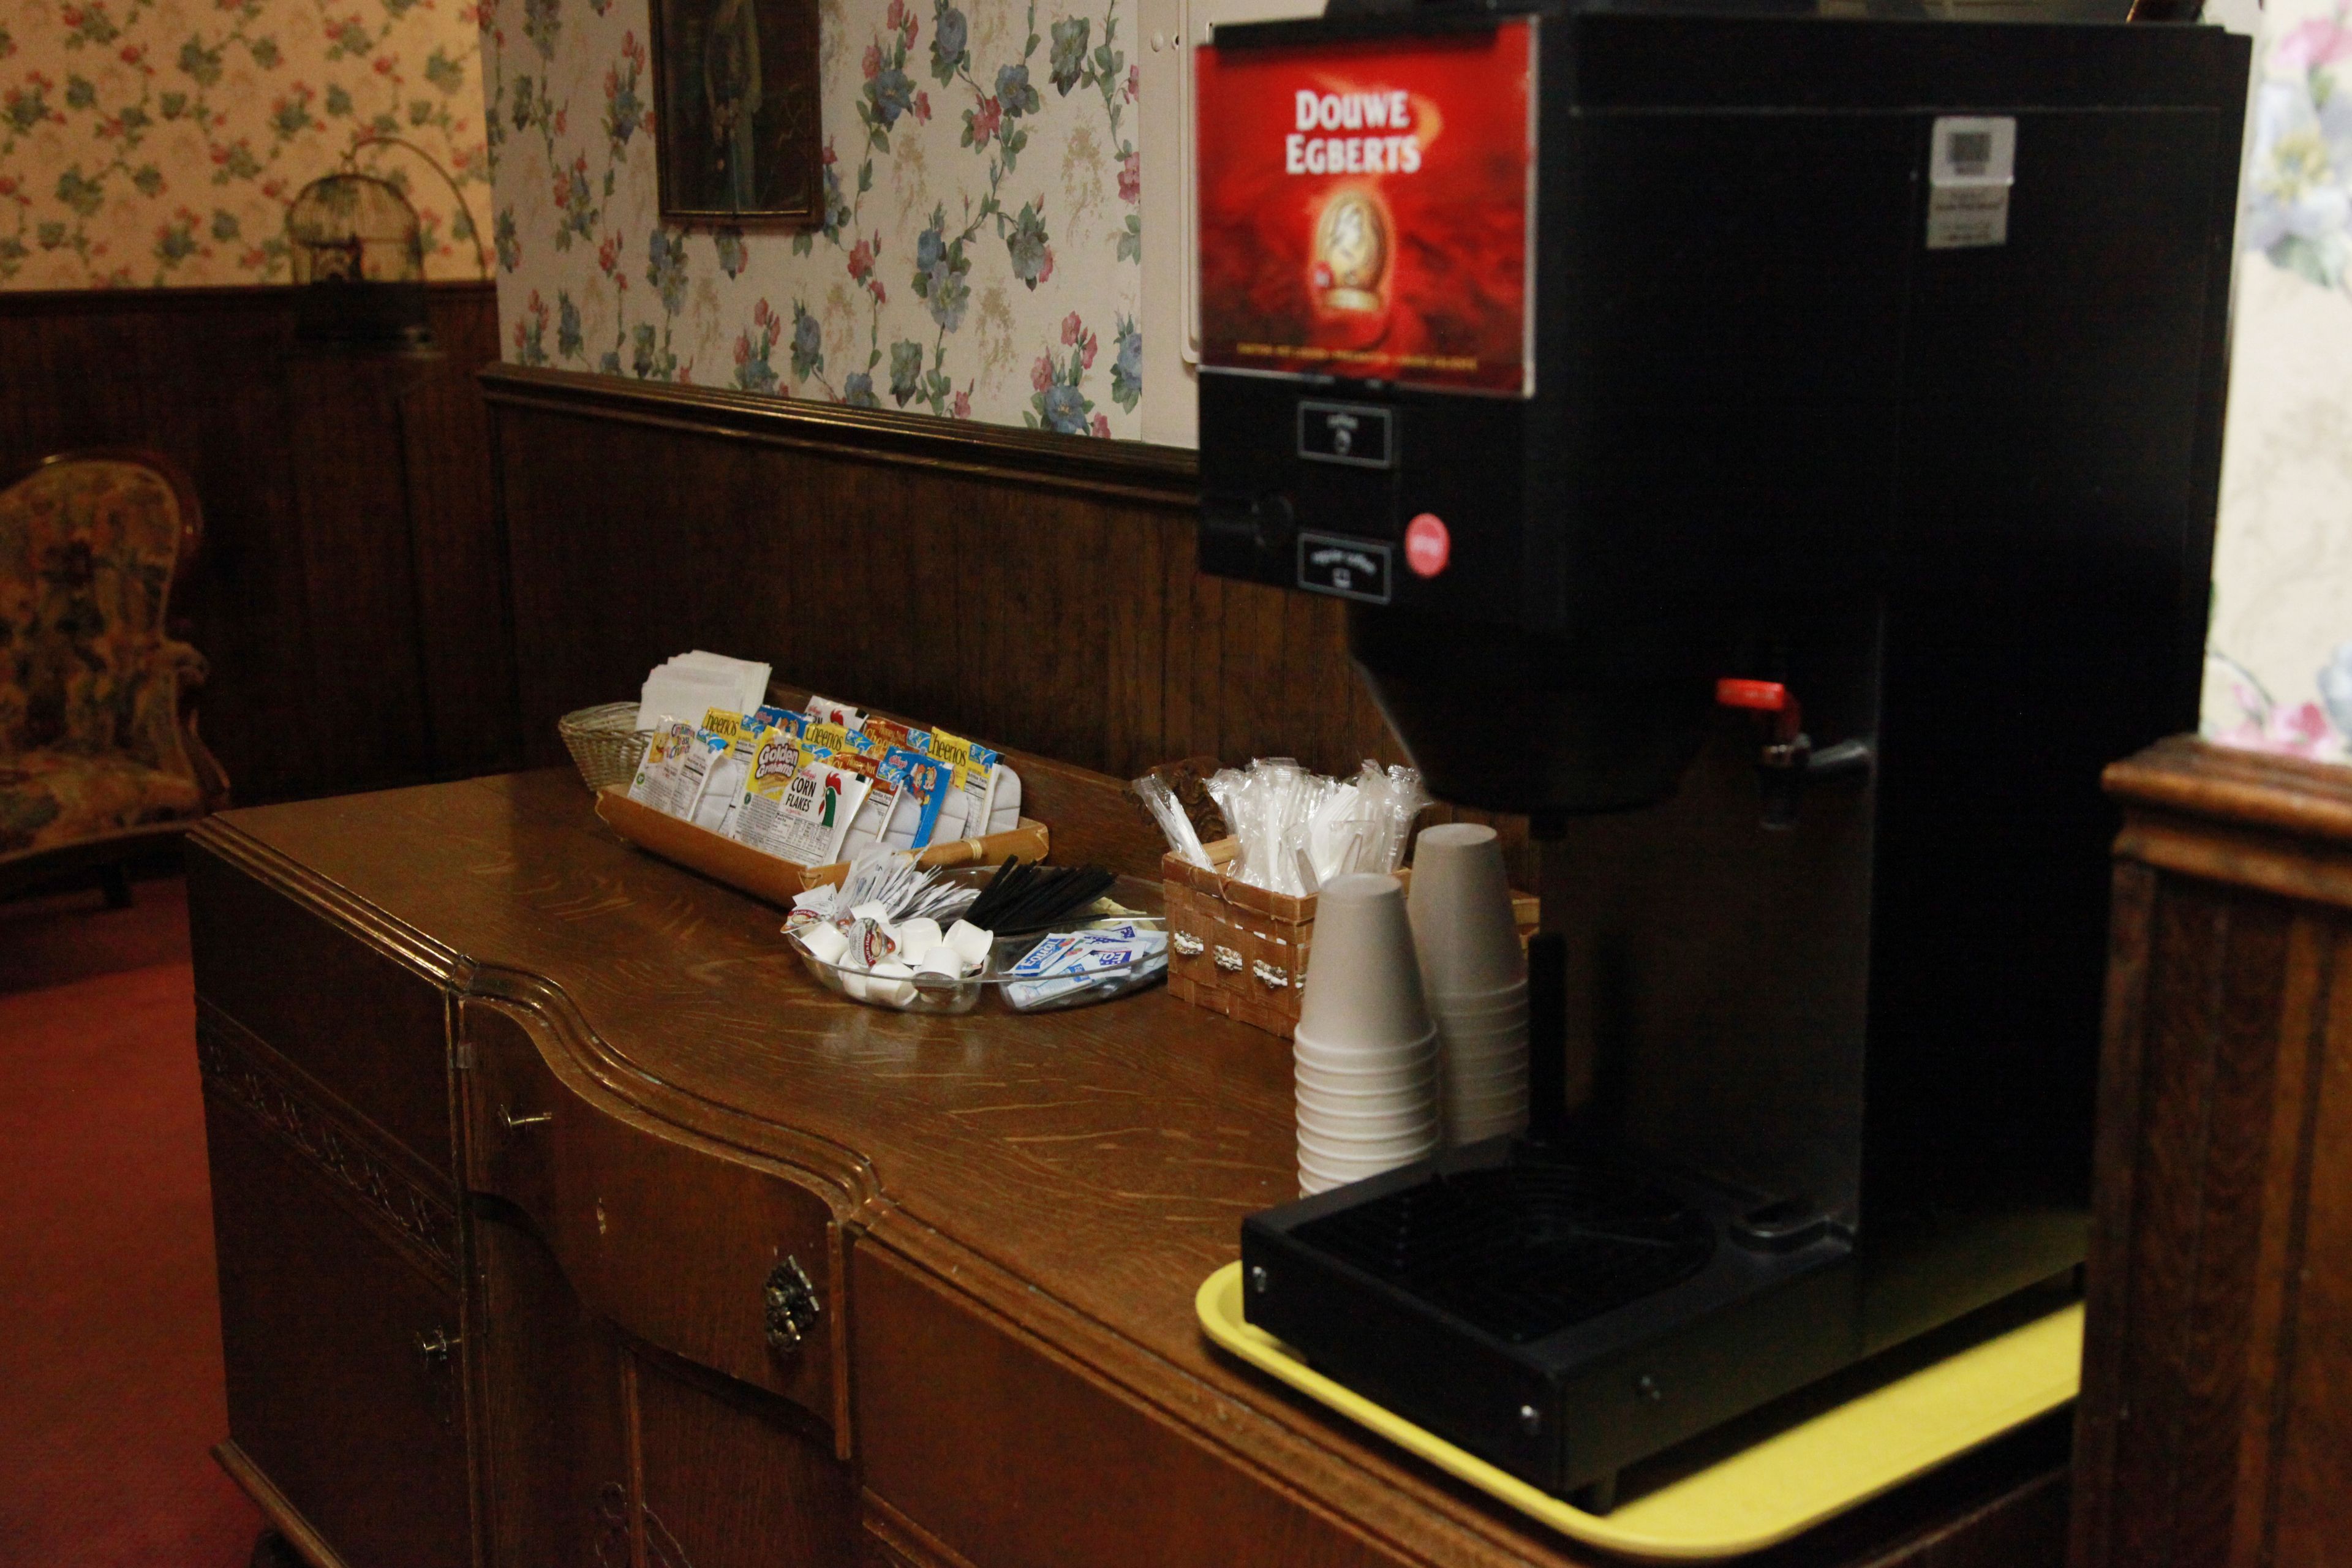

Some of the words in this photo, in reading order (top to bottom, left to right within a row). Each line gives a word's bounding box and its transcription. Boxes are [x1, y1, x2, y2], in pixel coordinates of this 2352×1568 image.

[1295, 89, 1411, 131] DOUWE
[1286, 133, 1422, 175] EGBERTS
[706, 710, 739, 736] heerios
[805, 725, 843, 752] Cheerios
[927, 733, 968, 767] Cheerios
[759, 743, 799, 766] Golden
[755, 761, 794, 779] Grahams
[792, 776, 816, 797] CORN
[785, 793, 812, 812] FLAKES
